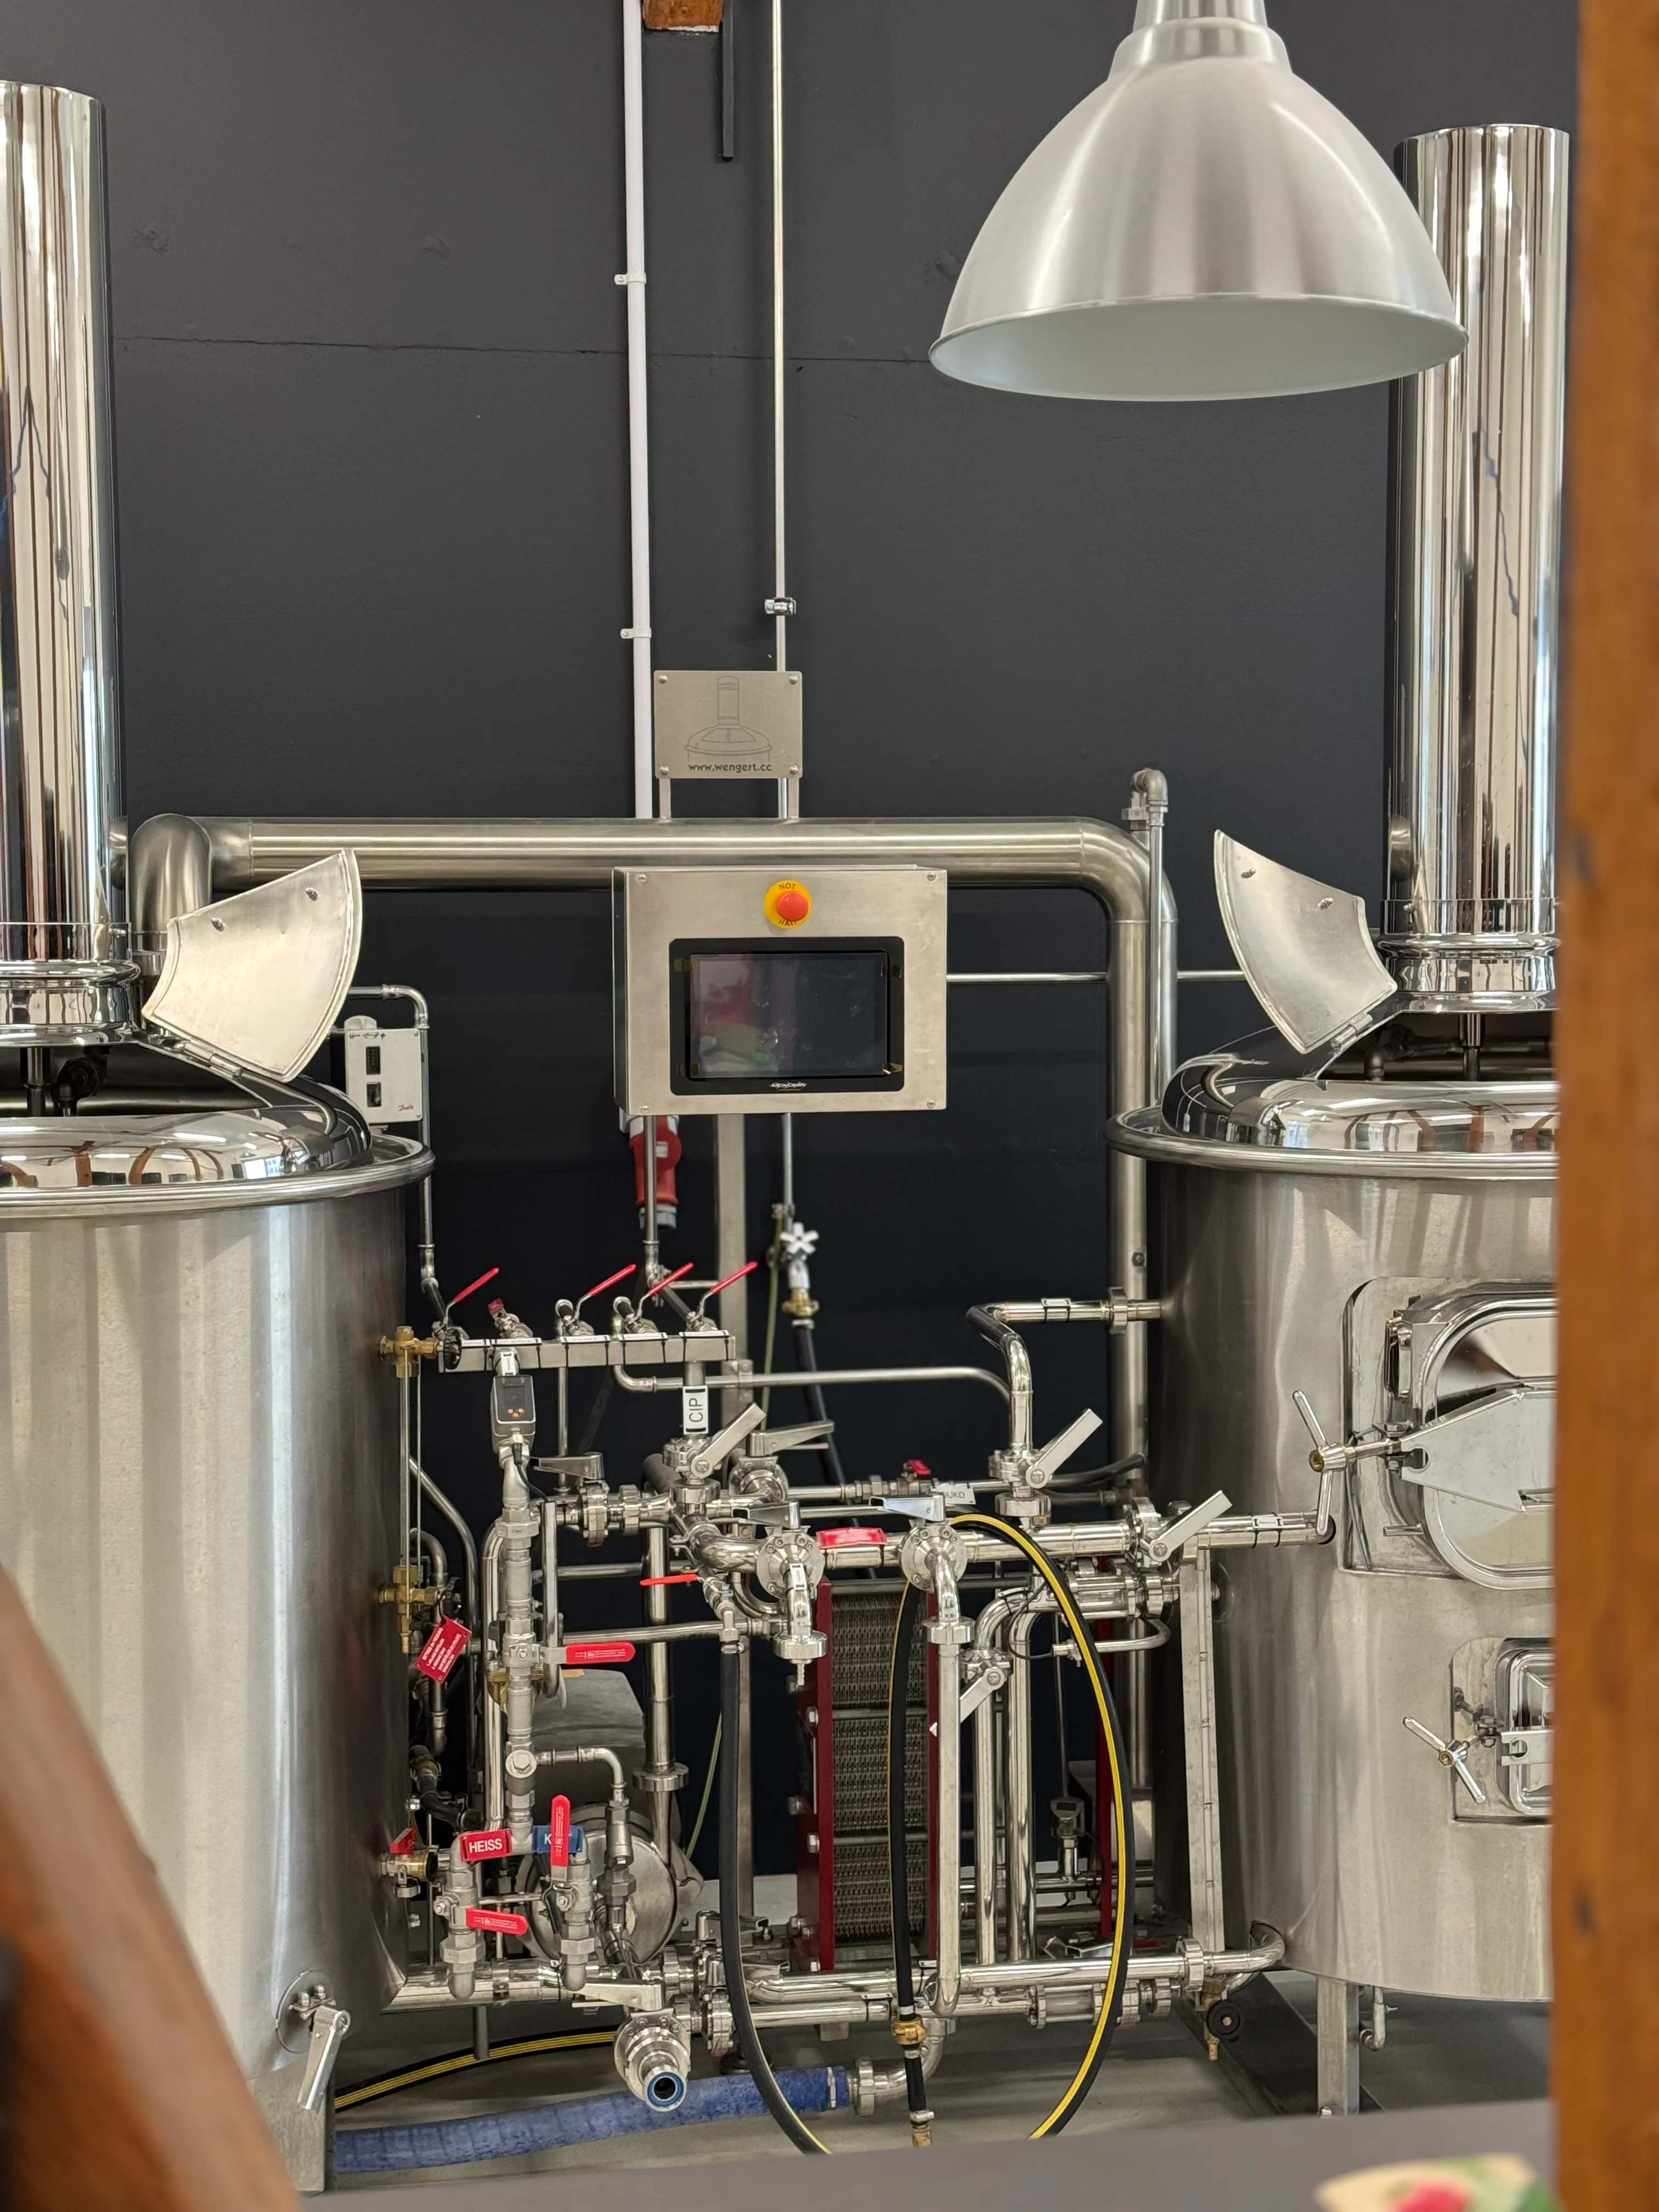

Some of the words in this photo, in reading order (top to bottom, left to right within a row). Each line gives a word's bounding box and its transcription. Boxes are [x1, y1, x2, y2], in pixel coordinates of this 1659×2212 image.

[689, 763, 772, 773] www.wengert.cc
[689, 1398, 703, 1422] CIP
[469, 1838, 503, 1854] HEISS
